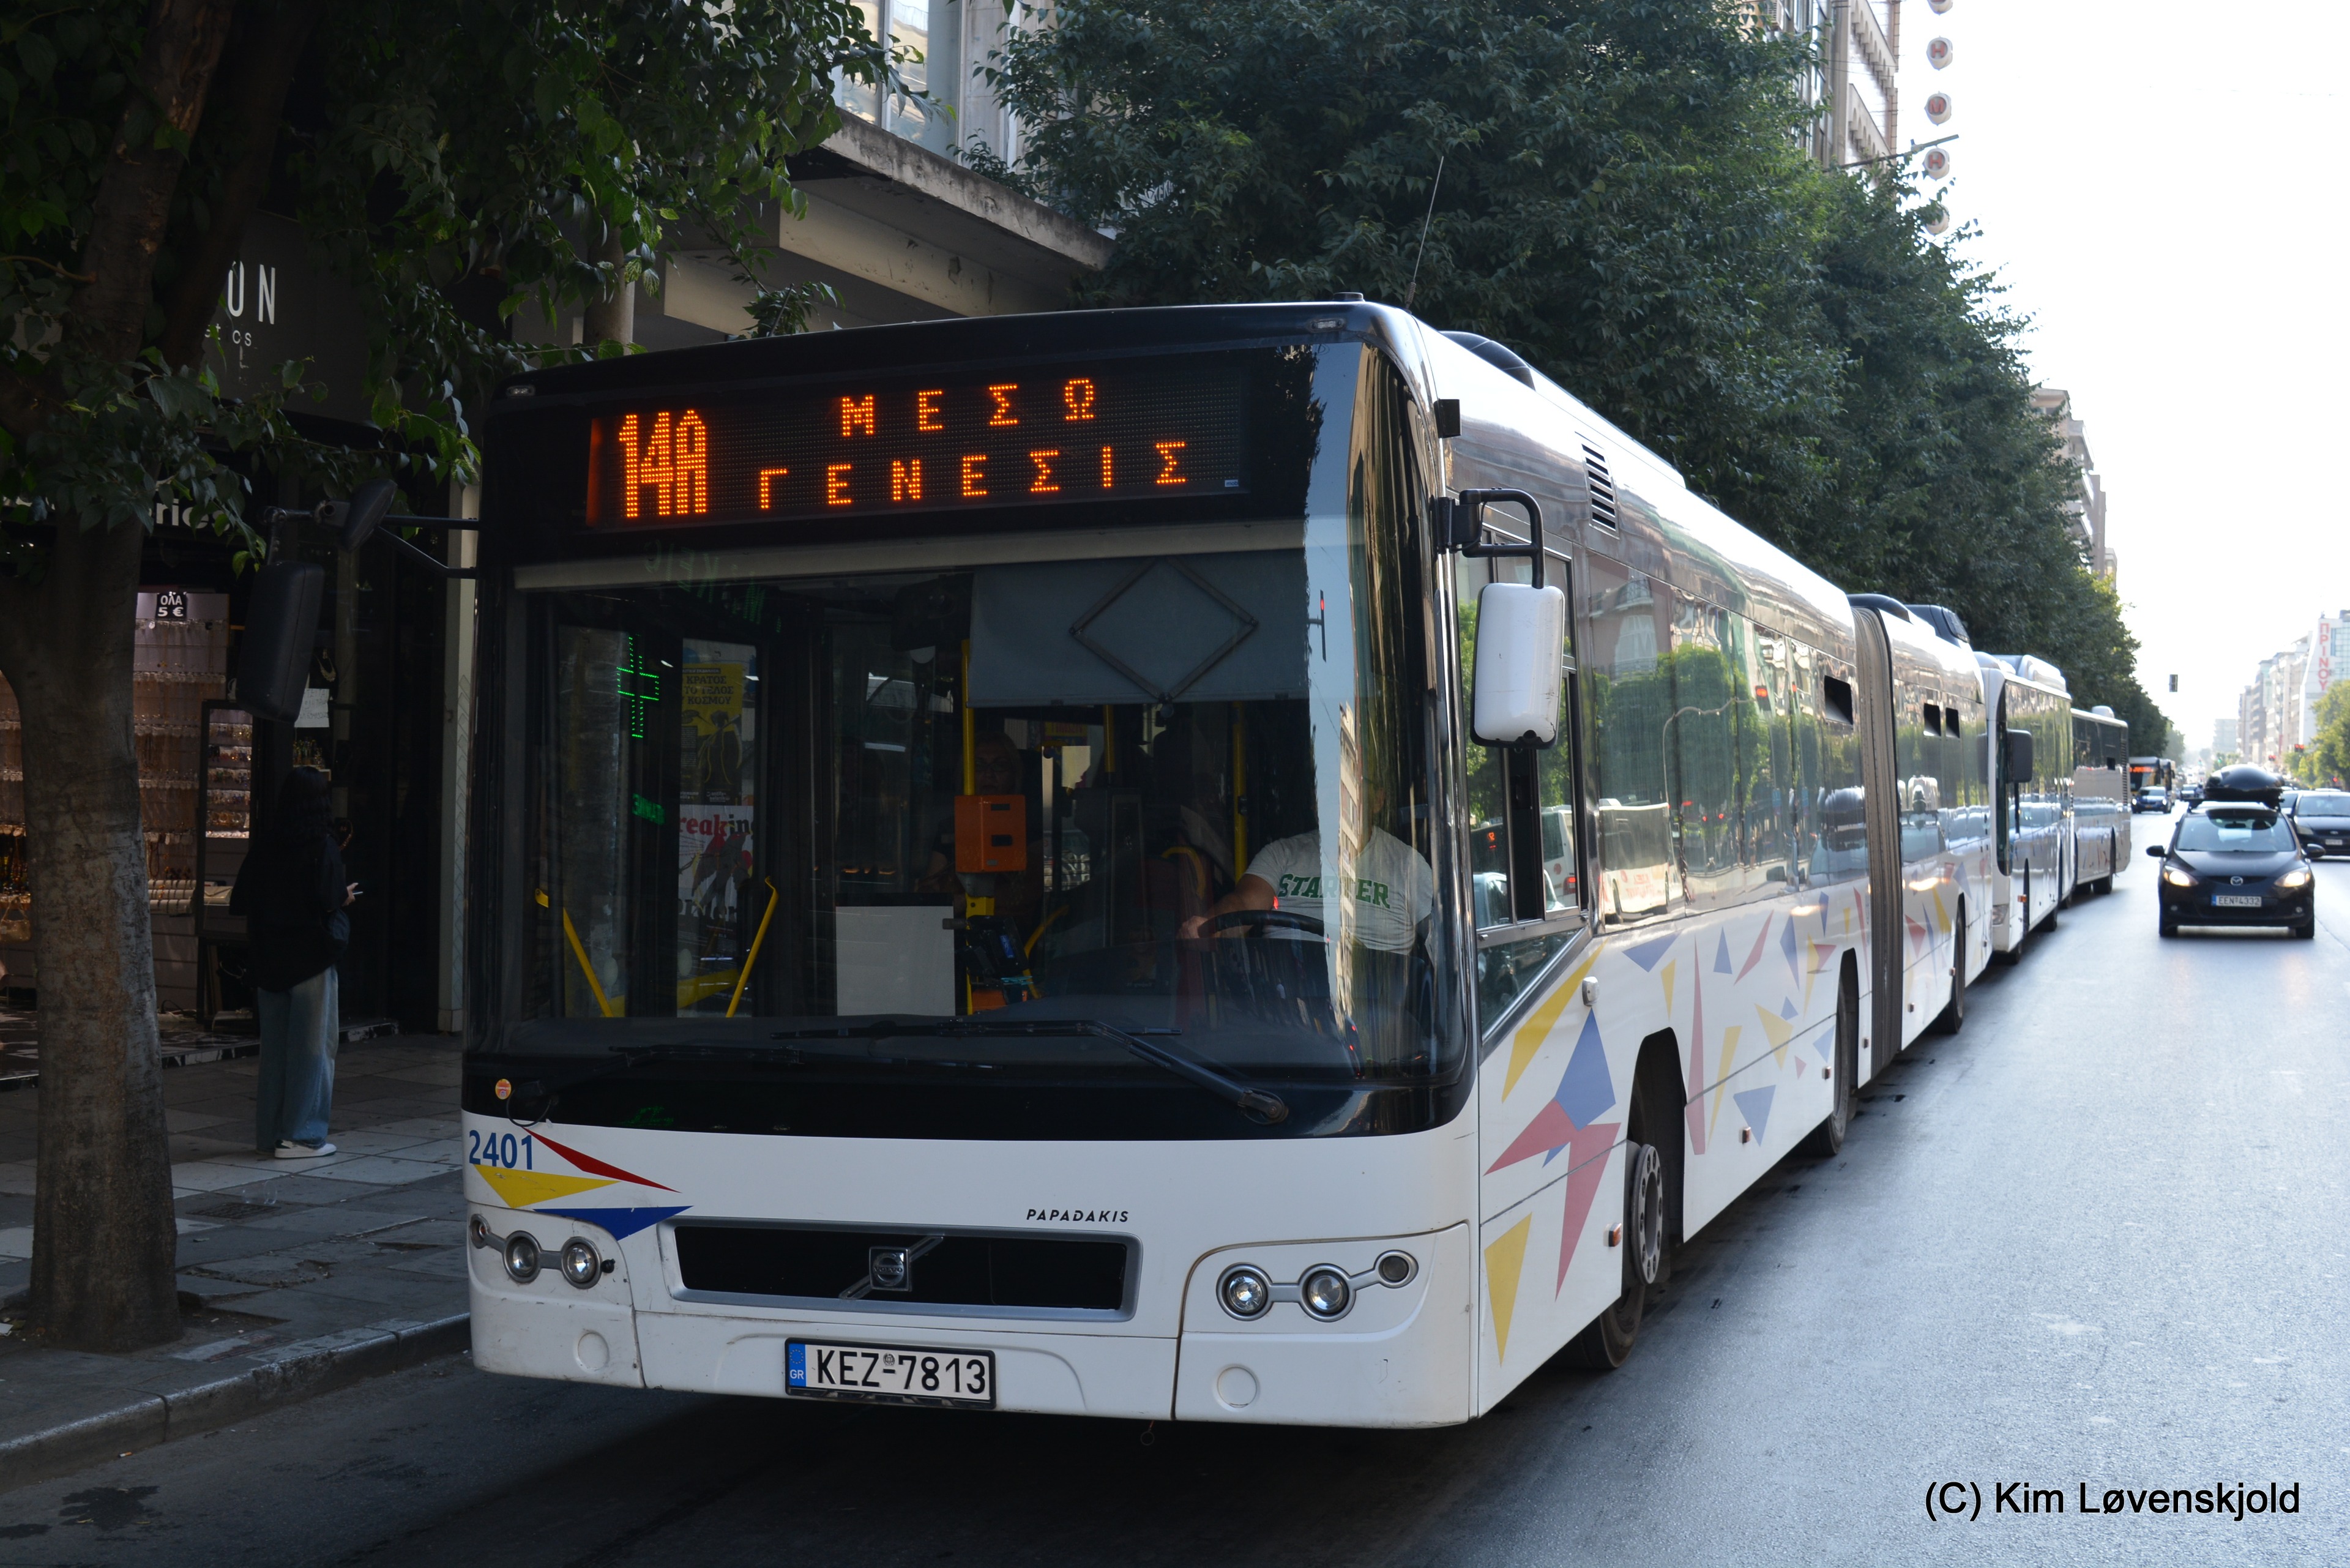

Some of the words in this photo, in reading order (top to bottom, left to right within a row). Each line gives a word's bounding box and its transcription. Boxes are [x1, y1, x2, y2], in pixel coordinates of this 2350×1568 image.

[227, 260, 275, 325] ON
[841, 378, 1095, 438] ΜΕΣΩ
[759, 441, 1188, 510] ΓΕΝΕΣΙΣ
[157, 607, 168, 617] 5
[2318, 622, 2329, 691] ΠΡΙΝΟΥ
[686, 676, 727, 684] ΚΡΑΤΟΣ
[687, 696, 731, 705] ΚΟΣΜΟΥ
[679, 814, 753, 839] reakin
[1277, 873, 1391, 909] STARER
[469, 1129, 532, 1170] 2401
[1026, 1209, 1128, 1222] PAPADAKIS
[789, 1369, 804, 1380] GR
[816, 1349, 986, 1394] KEZ-7813
